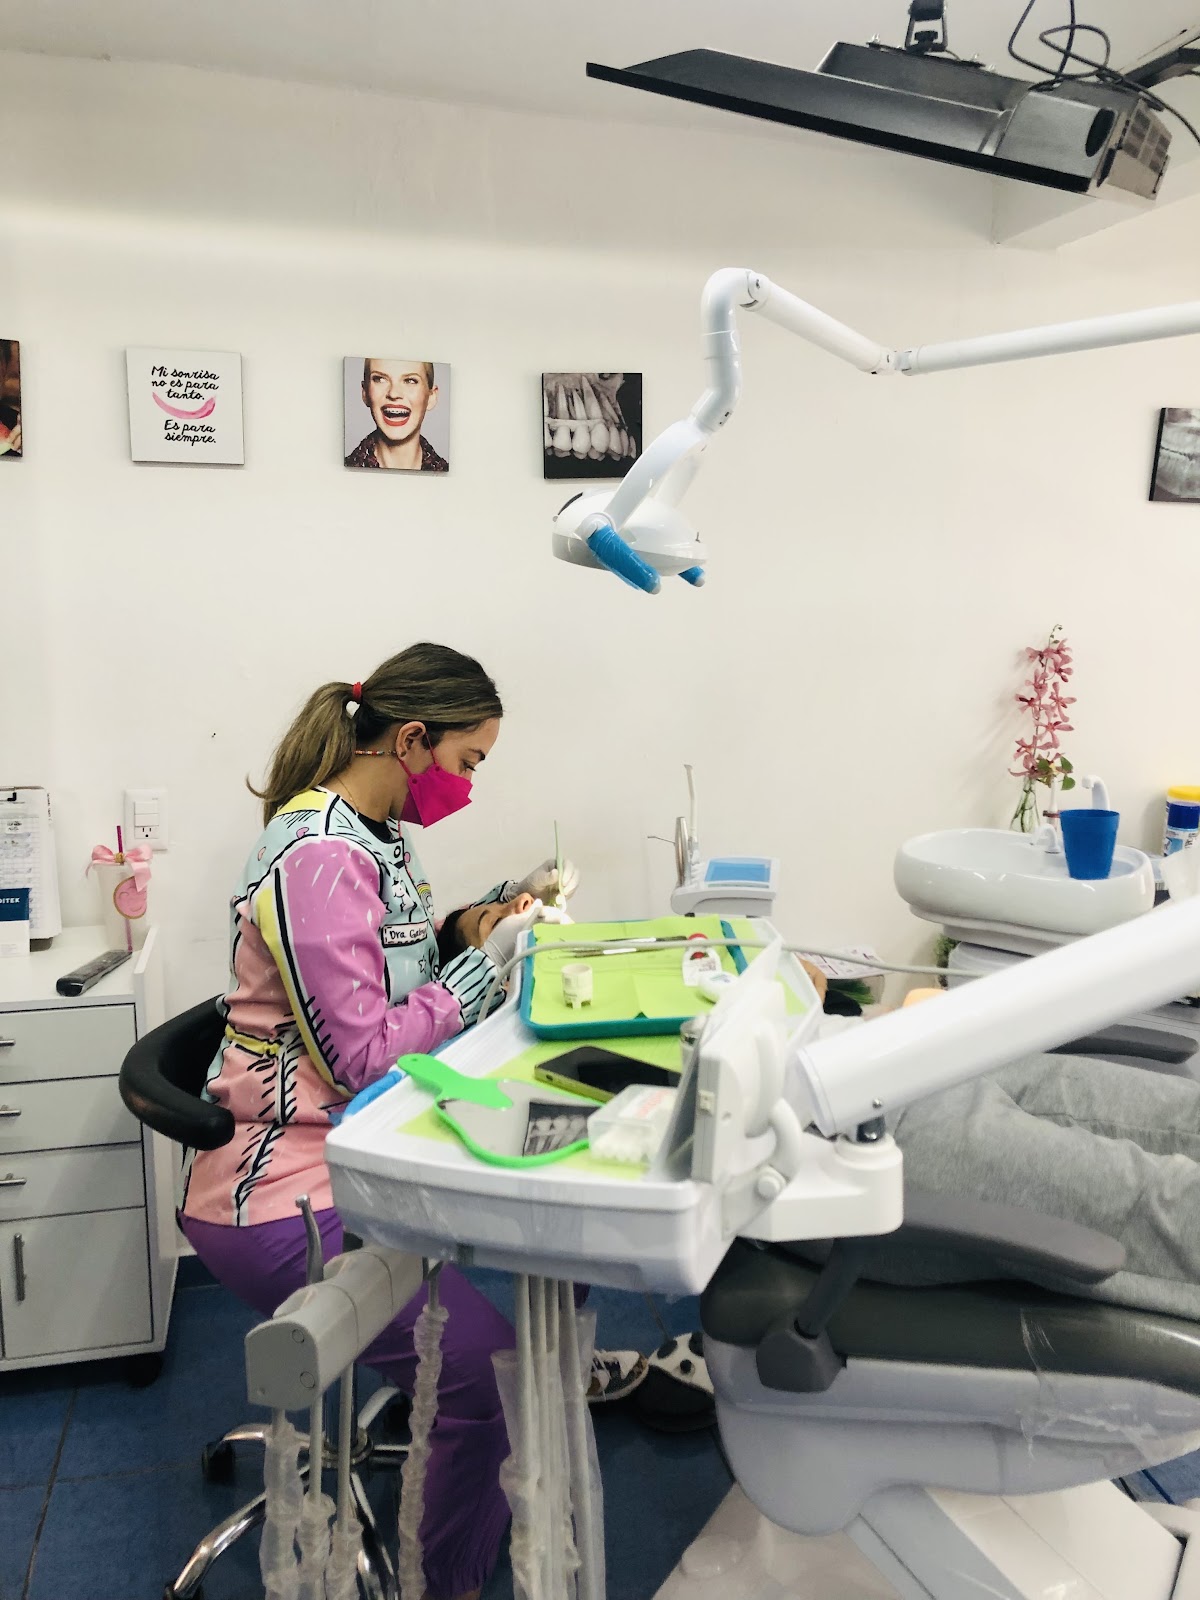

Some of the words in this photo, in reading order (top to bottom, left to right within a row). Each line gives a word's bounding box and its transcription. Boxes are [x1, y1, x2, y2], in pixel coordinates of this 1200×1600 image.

[151, 366, 168, 377] Mi
[170, 368, 220, 381] sonrisa
[169, 379, 183, 388] es
[184, 381, 220, 393] para
[166, 388, 205, 400] tanto.
[164, 419, 180, 431] Es
[181, 423, 216, 435] para
[164, 432, 217, 446] siempre.
[390, 930, 406, 940] Dra
